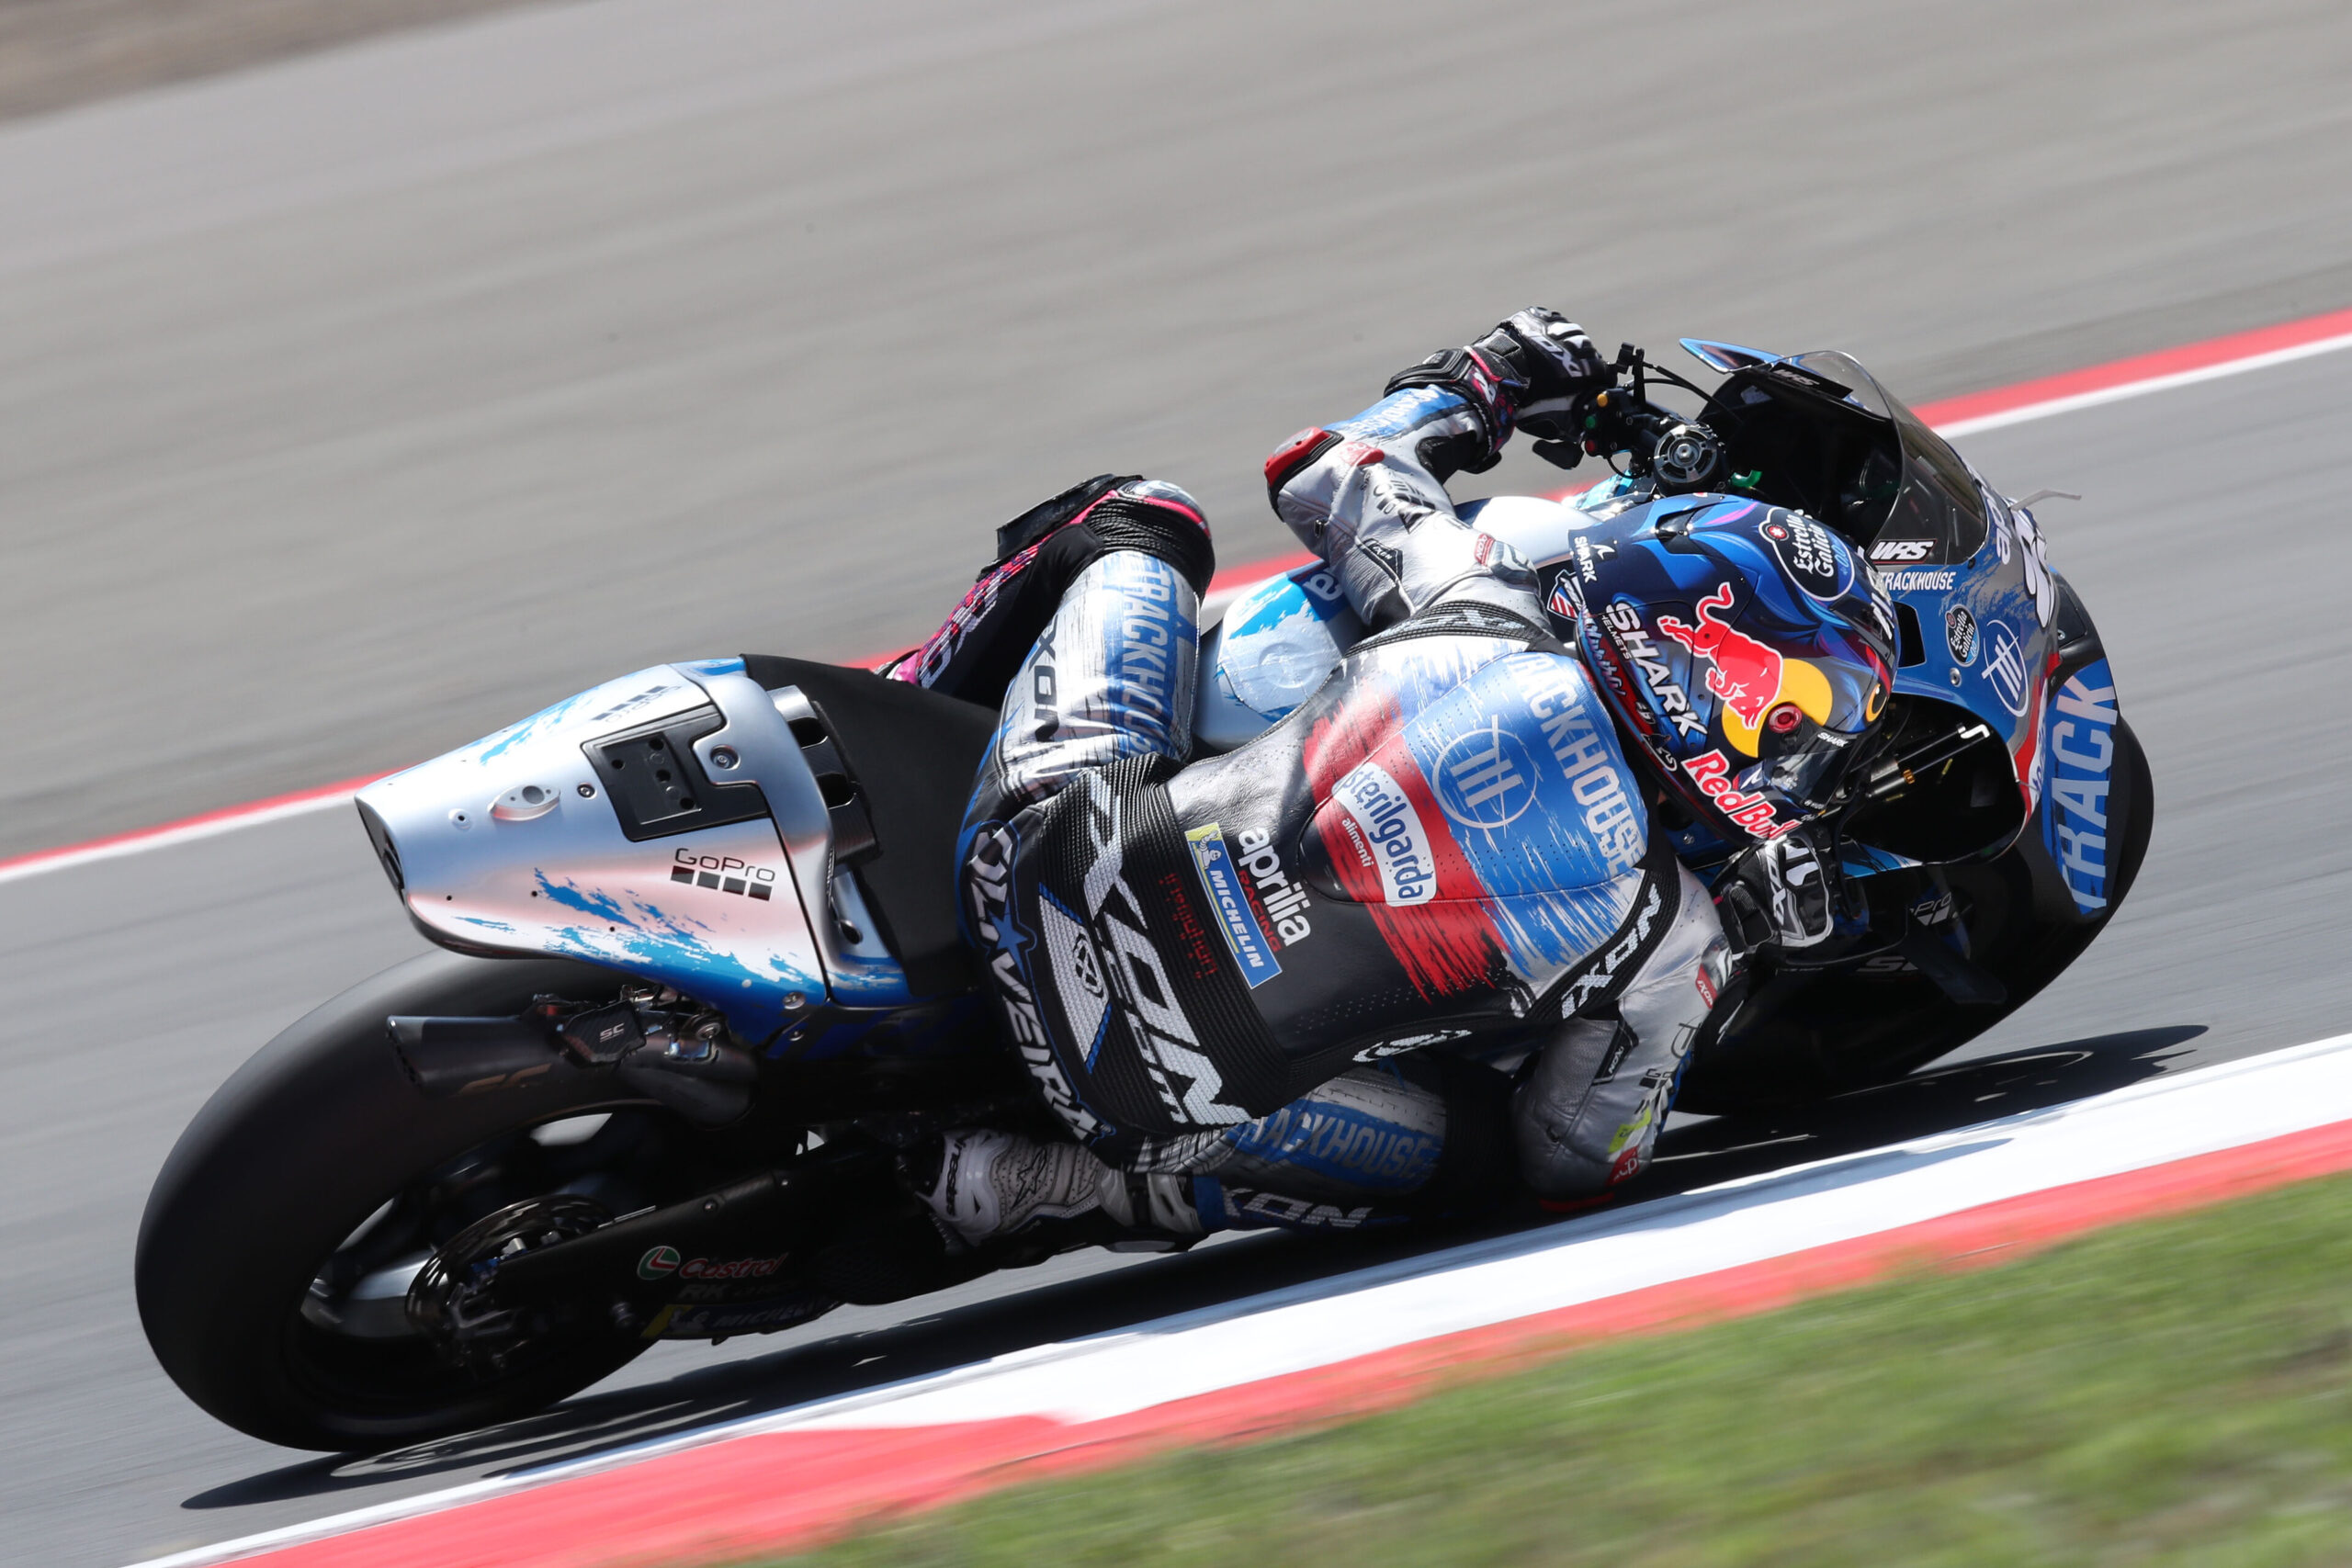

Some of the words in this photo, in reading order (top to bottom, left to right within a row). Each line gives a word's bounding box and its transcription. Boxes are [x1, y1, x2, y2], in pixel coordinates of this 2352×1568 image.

[1574, 536, 1597, 583] SHARK
[1870, 541, 1934, 560] WRS
[1601, 615, 1633, 660] HELMETS
[1951, 610, 1968, 651] Estrella
[1960, 623, 1975, 658] Galicia
[1122, 567, 1172, 761] TRACKHOUS
[1606, 602, 1709, 738] SHARK
[1341, 818, 1374, 868] alimenti
[1342, 770, 1432, 899] sterilgarda
[675, 847, 775, 883] GoPro
[1238, 828, 1311, 947] aprilia
[1210, 870, 1264, 968] MICHELIN
[1238, 870, 1283, 953] RACING
[1910, 890, 1952, 919] Pro
[1562, 882, 1664, 1020] IXON
[1251, 1107, 1430, 1179] ACKHOUSE
[679, 1252, 790, 1280] Castrol
